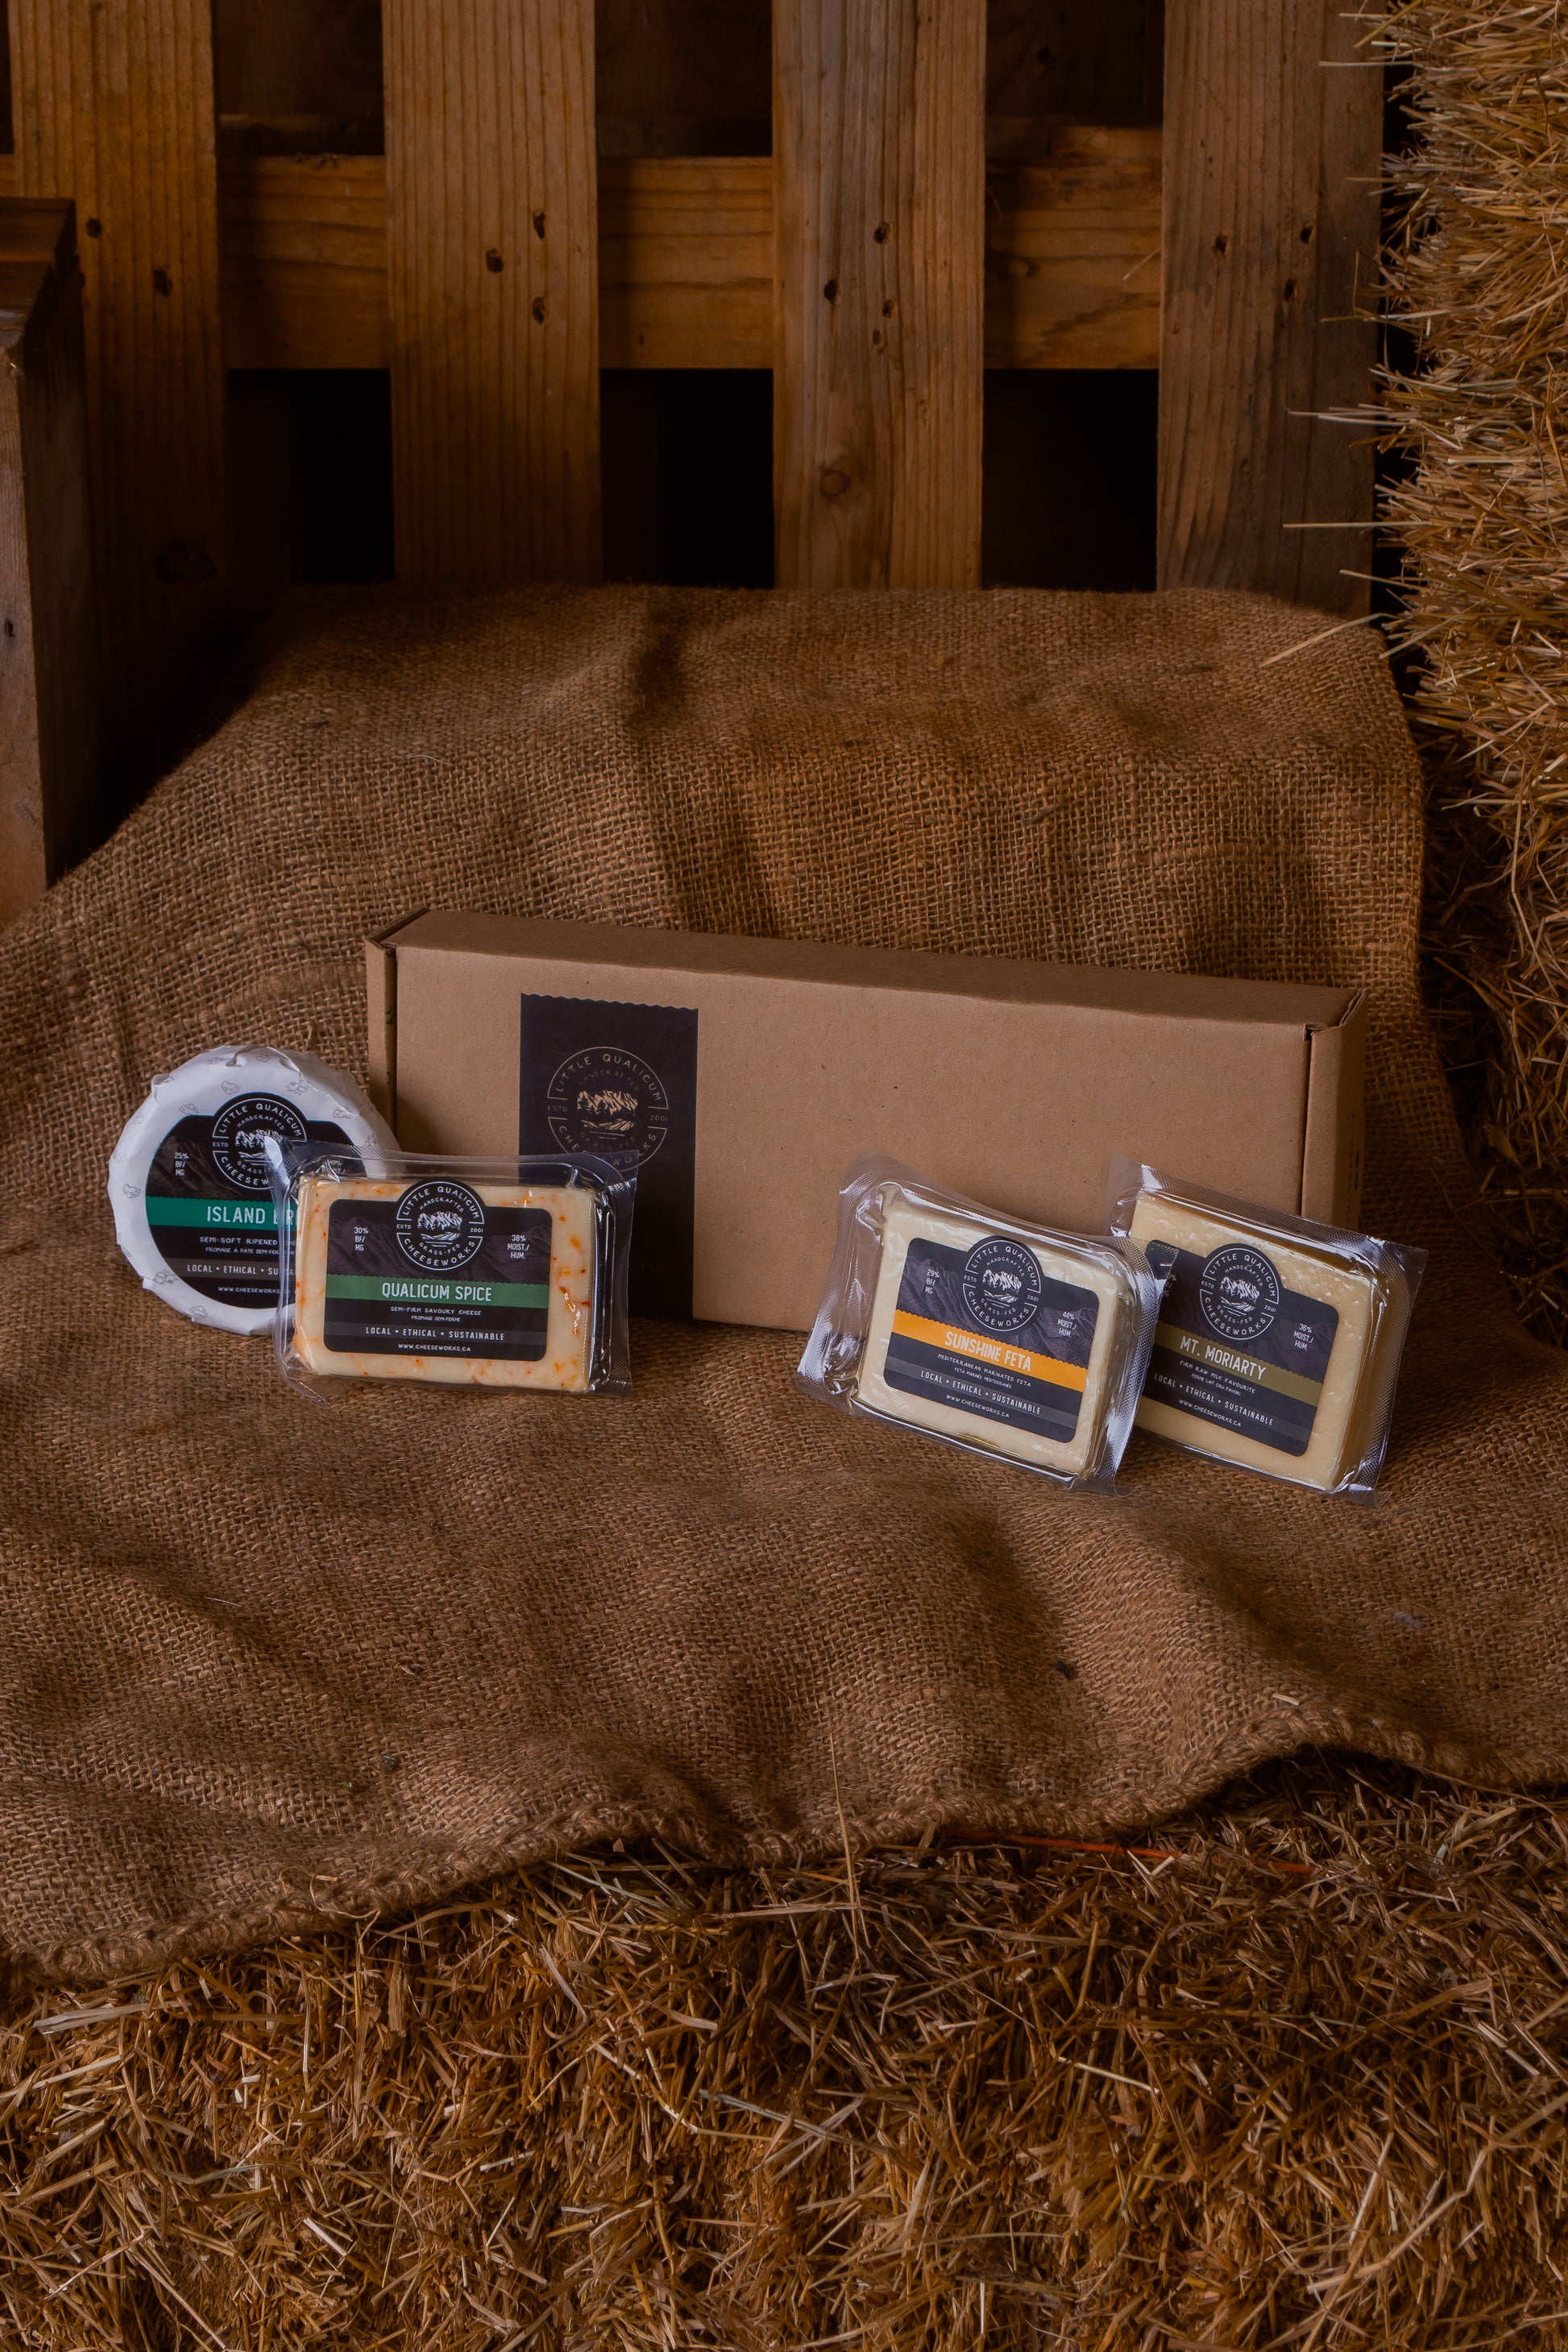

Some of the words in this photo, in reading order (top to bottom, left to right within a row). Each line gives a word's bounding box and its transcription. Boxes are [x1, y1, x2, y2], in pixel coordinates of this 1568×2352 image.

[554, 1056, 592, 1093] LITTLE
[603, 1053, 662, 1101] QUALICUM
[218, 1105, 248, 1134] LITTLE
[255, 1103, 302, 1137] QUALICUM
[237, 1114, 285, 1130] HANDCRAFTED
[403, 1188, 430, 1216] LITTLE
[437, 1186, 479, 1219] QUALICUM
[419, 1197, 464, 1213] HANDCRAFTED
[207, 1205, 266, 1224] ISLAND
[200, 1236, 242, 1244] SEMI-SOFT
[419, 1242, 460, 1255] GRASS-FED
[404, 1238, 475, 1266] CHEESEWORKS
[187, 1263, 214, 1273] LOCAL
[223, 1265, 257, 1275] ETHICAL
[927, 1268, 940, 1278] 29%
[971, 1245, 998, 1268] LITTLE
[1005, 1246, 1038, 1286] QUALICUM
[986, 1256, 1025, 1277] HANDCRAFTED
[1209, 1253, 1238, 1275] LITTLE
[1244, 1255, 1276, 1296] QUALICUM
[1225, 1264, 1263, 1287] HANDCRAFTED
[927, 1277, 935, 1286] BF/
[964, 1275, 977, 1283] ESTD
[1201, 1280, 1215, 1289] ESTD
[382, 1282, 450, 1300] QUALICUM
[454, 1286, 492, 1302] SPICE
[925, 1286, 934, 1294] MG
[1027, 1294, 1039, 1302] 2001
[969, 1291, 1030, 1327] CHEESEWORKS
[981, 1298, 1016, 1316] GRASS-FED
[1063, 1311, 1075, 1320] 44%
[1205, 1297, 1267, 1336] CHEESEWORKS
[1217, 1305, 1253, 1325] GRASS-FED
[1263, 1305, 1276, 1313] 2001
[365, 1326, 392, 1335] LOCAL
[403, 1328, 437, 1338] ETHICAL
[449, 1330, 505, 1341] SUSTAINABLE
[1299, 1323, 1313, 1334] 36%
[397, 1343, 471, 1352] WWW.CHEESEWORKS.CA
[944, 1331, 1002, 1362] SUNSHINE
[1004, 1347, 1032, 1372] FETA
[1180, 1335, 1201, 1357] MT.
[1205, 1346, 1267, 1380] MORIARTY
[937, 1354, 982, 1371] MEDITERRANEAN
[983, 1368, 1014, 1383] MARINATED
[1016, 1379, 1031, 1388] FETA
[1180, 1360, 1193, 1370] FIRM
[1195, 1366, 1209, 1375] RAW
[1210, 1372, 1223, 1380] MILK
[1224, 1377, 1257, 1395] FAVOURITE
[1191, 1373, 1205, 1383] FERME
[920, 1370, 943, 1383] LOCAL
[952, 1380, 982, 1396] ETHICAL
[992, 1392, 1041, 1415] SUSTAINABLE
[1154, 1372, 1176, 1388] LOCAL
[1185, 1385, 1215, 1404] ETHICAL
[1224, 1401, 1274, 1427] SUSTAINABLE
[946, 1394, 1010, 1418] WWW.CHEESEWORKS.CA
[1179, 1399, 1242, 1428] WWW.CHEESEWORKS.CA
